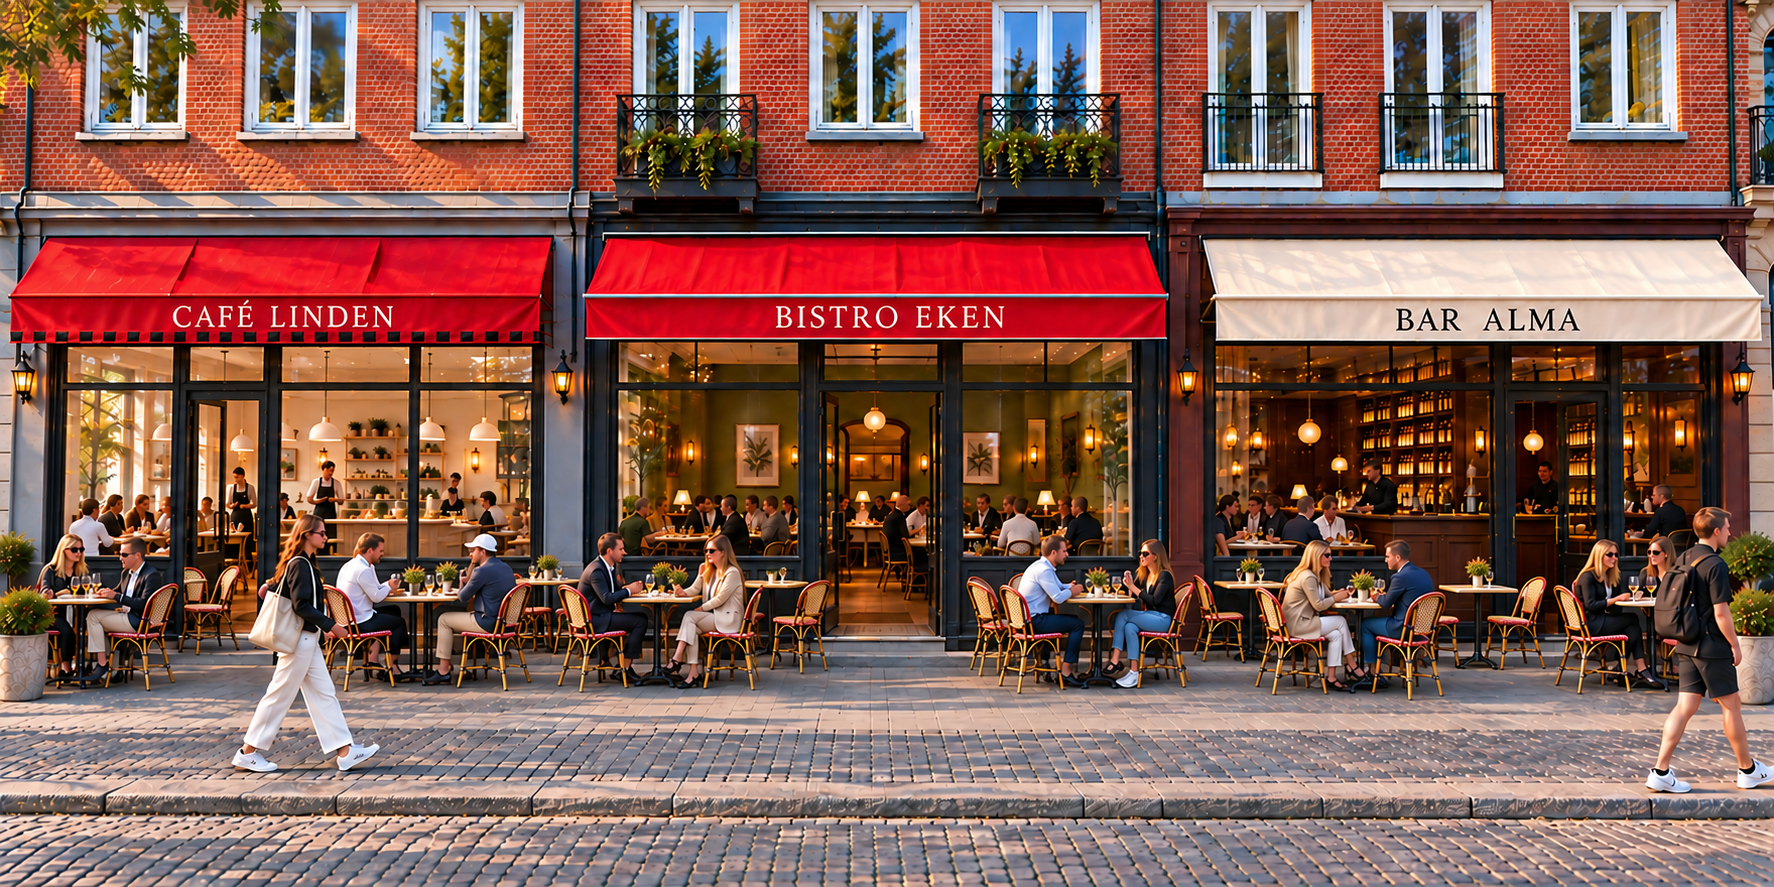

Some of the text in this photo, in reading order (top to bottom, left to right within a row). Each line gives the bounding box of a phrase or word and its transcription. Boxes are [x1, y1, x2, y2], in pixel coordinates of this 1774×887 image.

[172, 299, 394, 328] CAFÉ LINDEN
[775, 305, 1005, 329] BISTRO EKEN
[1395, 307, 1581, 332] BAR ALMA
